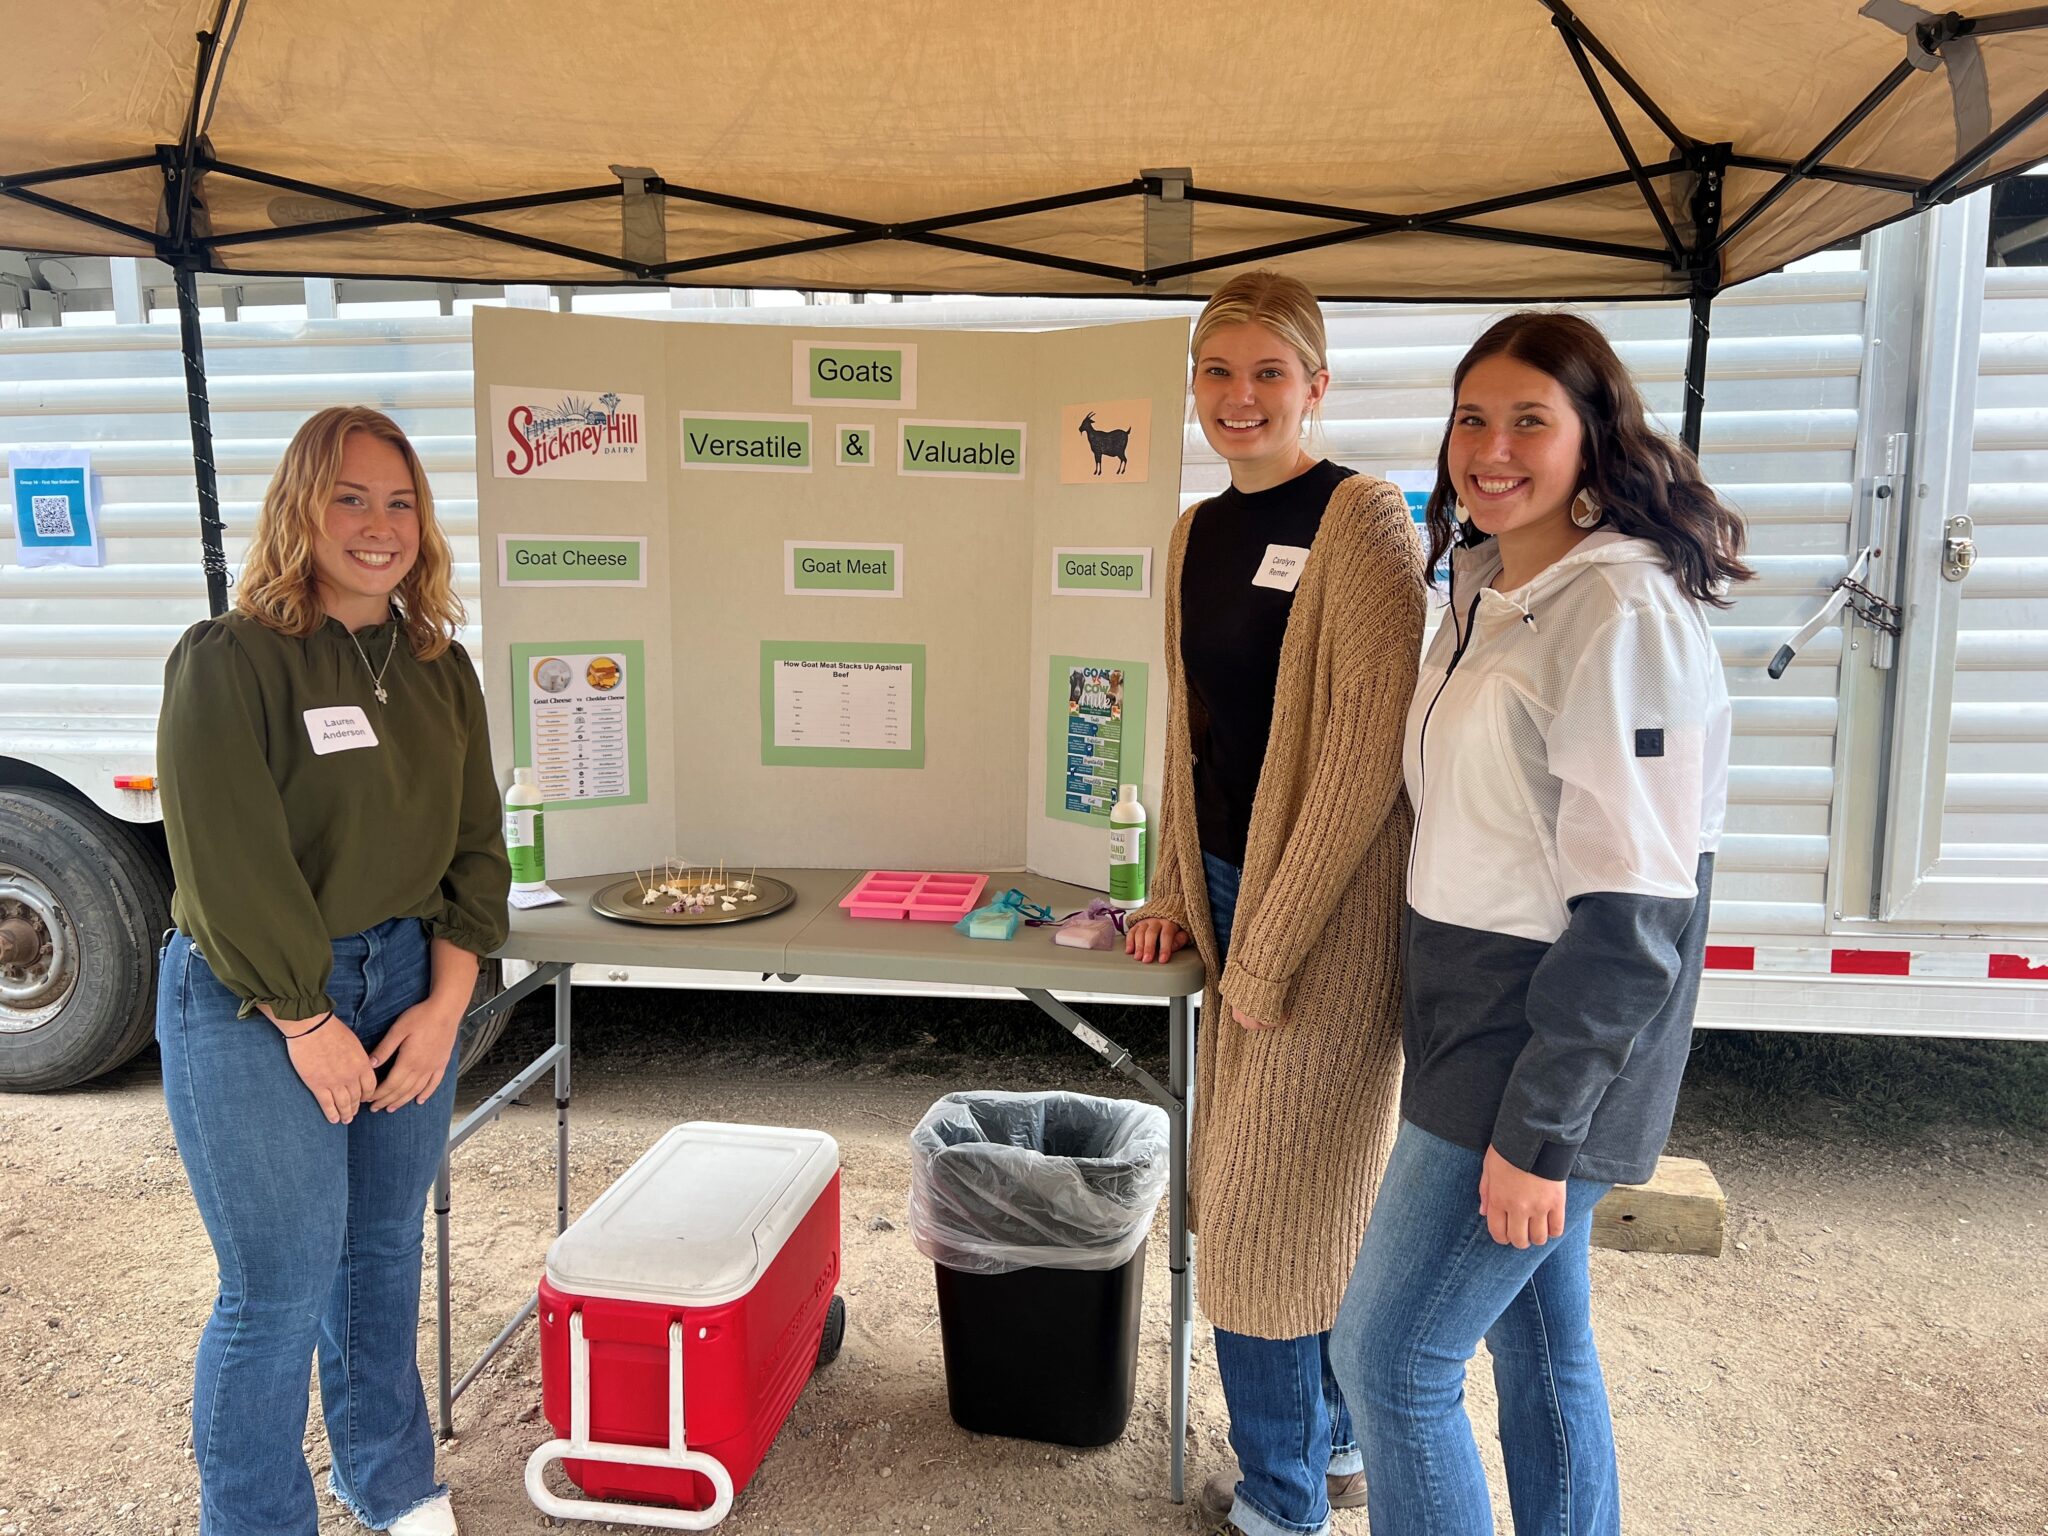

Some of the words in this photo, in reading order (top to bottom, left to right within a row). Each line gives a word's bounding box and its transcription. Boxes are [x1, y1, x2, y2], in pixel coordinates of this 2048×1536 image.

[817, 358, 893, 383] Goats
[507, 405, 605, 475] Stickney
[607, 414, 638, 445] Hill
[604, 446, 636, 455] DAIRY
[690, 433, 802, 459] Versatile
[846, 433, 864, 457] &
[906, 439, 1015, 466] Valuable
[515, 550, 557, 566] Goat
[562, 551, 628, 567] Cheese
[1272, 556, 1296, 567] Carolyn
[801, 558, 841, 574] Goat
[847, 559, 888, 575] Meat
[1065, 561, 1097, 577] Goat
[1100, 561, 1134, 580] Soap
[783, 660, 800, 668] How
[838, 662, 862, 670] Stacks
[864, 663, 874, 671] Up
[875, 663, 902, 672] Against
[1083, 667, 1111, 679] GOAT
[1084, 683, 1110, 694] COW
[323, 718, 356, 728] Lauren
[322, 728, 366, 741] Anderson
